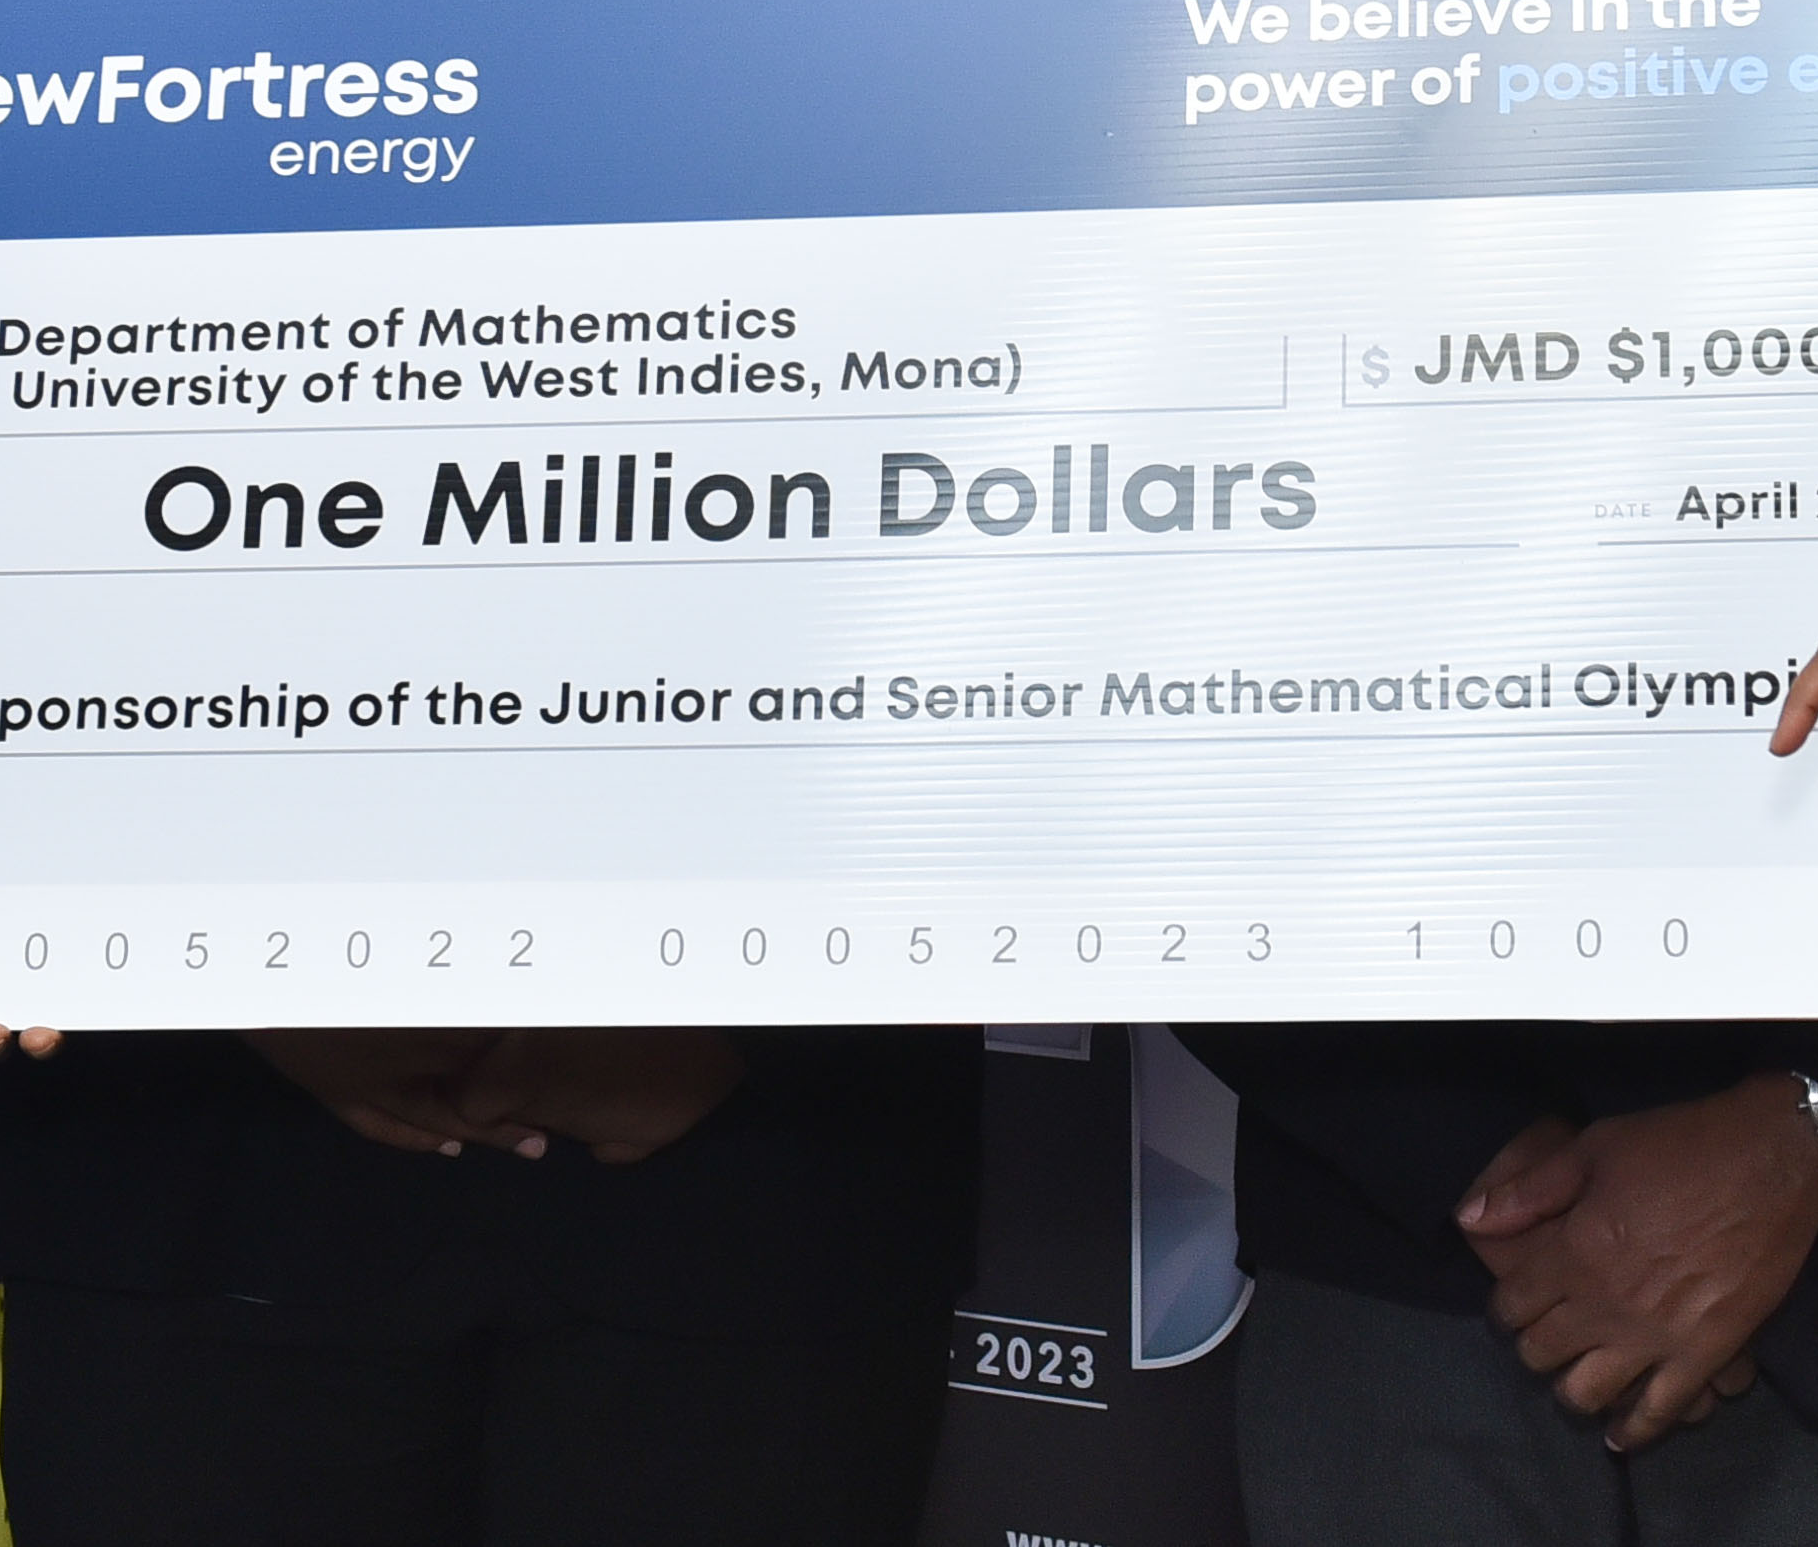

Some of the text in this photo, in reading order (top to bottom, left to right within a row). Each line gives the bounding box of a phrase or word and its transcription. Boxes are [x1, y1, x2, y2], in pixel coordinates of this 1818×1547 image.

[1184, 64, 1394, 125] power
[1411, 54, 1481, 105] of
[1498, 45, 1769, 114] positive
[270, 135, 475, 184] energy
[347, 307, 404, 349] of
[419, 300, 798, 348] Mathematics
[13, 362, 290, 413] University
[301, 360, 363, 402] of
[373, 358, 463, 401] the
[481, 357, 618, 400] West
[637, 350, 822, 400] Indies,
[840, 342, 1023, 396] Mona)
[1414, 332, 1580, 385] JMD
[144, 443, 1317, 552] One Million Dollars
[1594, 503, 1651, 518] DATE
[1676, 481, 1798, 529] April
[349, 682, 411, 727] of
[427, 682, 522, 725] the
[540, 678, 732, 725] Junior
[747, 676, 865, 723] and
[886, 671, 1083, 720] Senior
[1100, 663, 1552, 718] Mathematical
[976, 1332, 1095, 1389] 2023
